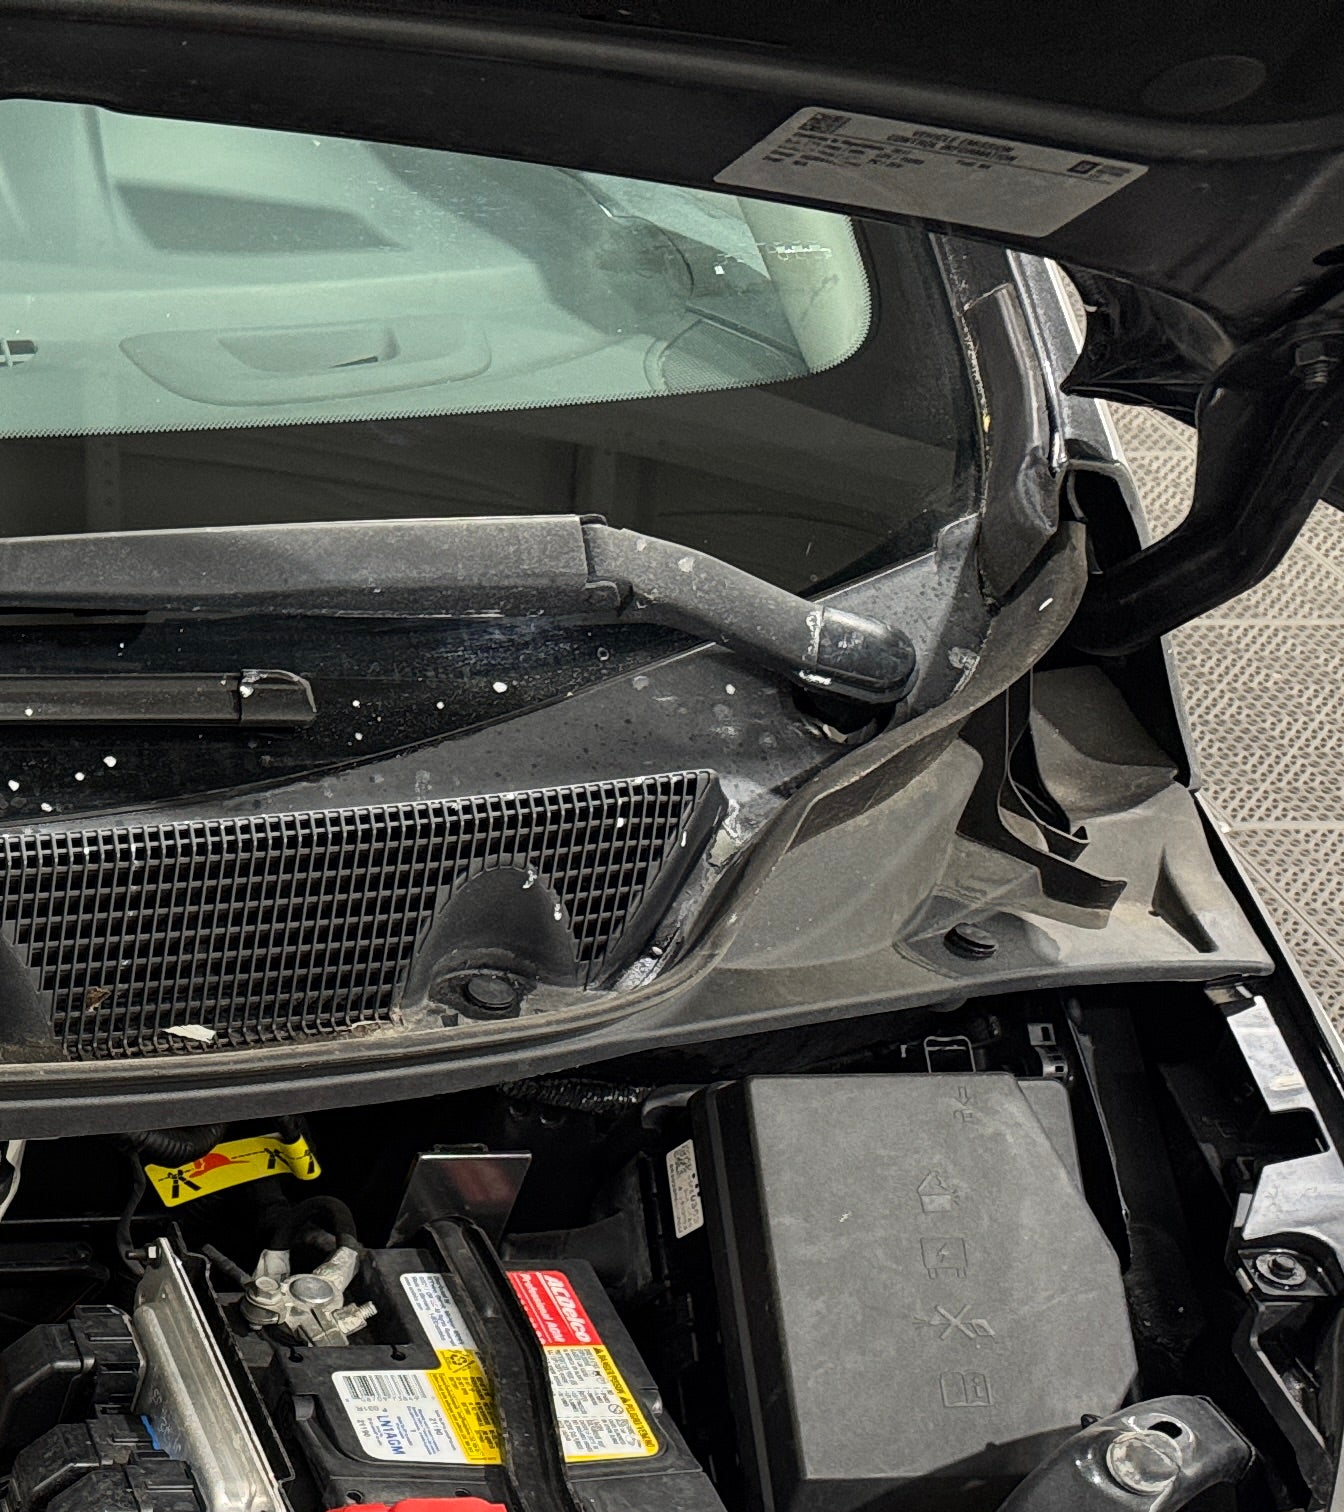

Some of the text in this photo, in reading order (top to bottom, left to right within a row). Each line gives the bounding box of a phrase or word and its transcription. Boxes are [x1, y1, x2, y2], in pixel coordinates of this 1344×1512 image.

[520, 1273, 553, 1321] Professional
[543, 1274, 591, 1343] ACDelco
[377, 1415, 405, 1454] LN1AGM
